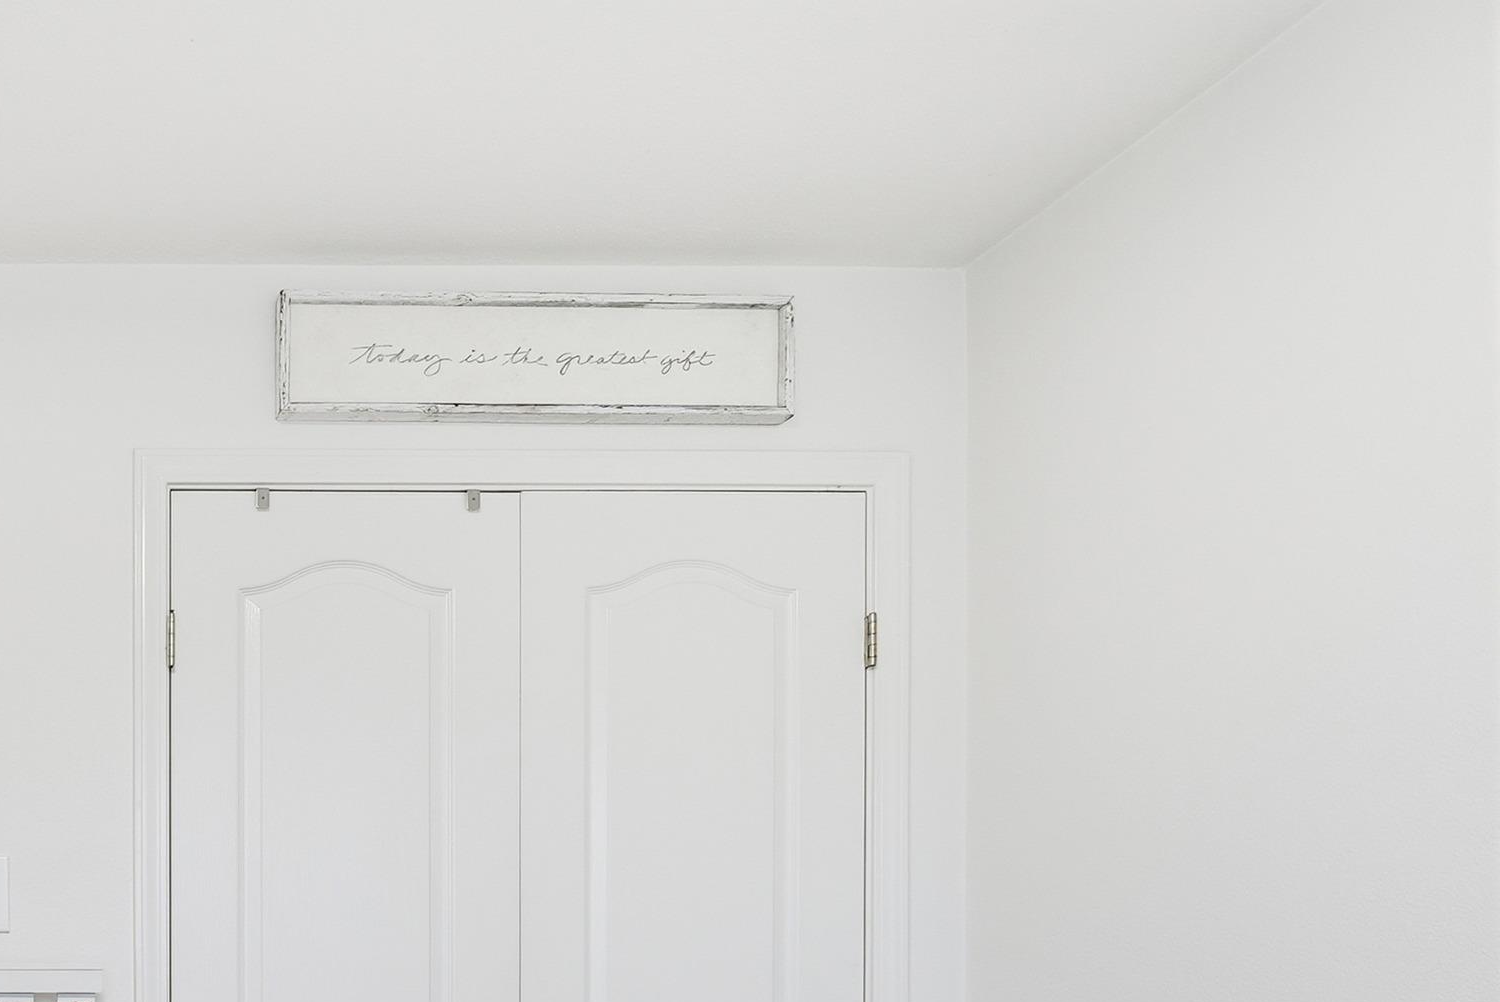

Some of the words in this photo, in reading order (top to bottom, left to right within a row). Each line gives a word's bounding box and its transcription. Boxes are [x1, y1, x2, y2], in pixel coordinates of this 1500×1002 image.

[349, 343, 452, 376] today
[459, 349, 498, 364] is
[502, 346, 548, 367] the
[556, 349, 658, 376] greatest
[660, 349, 716, 375] gift
